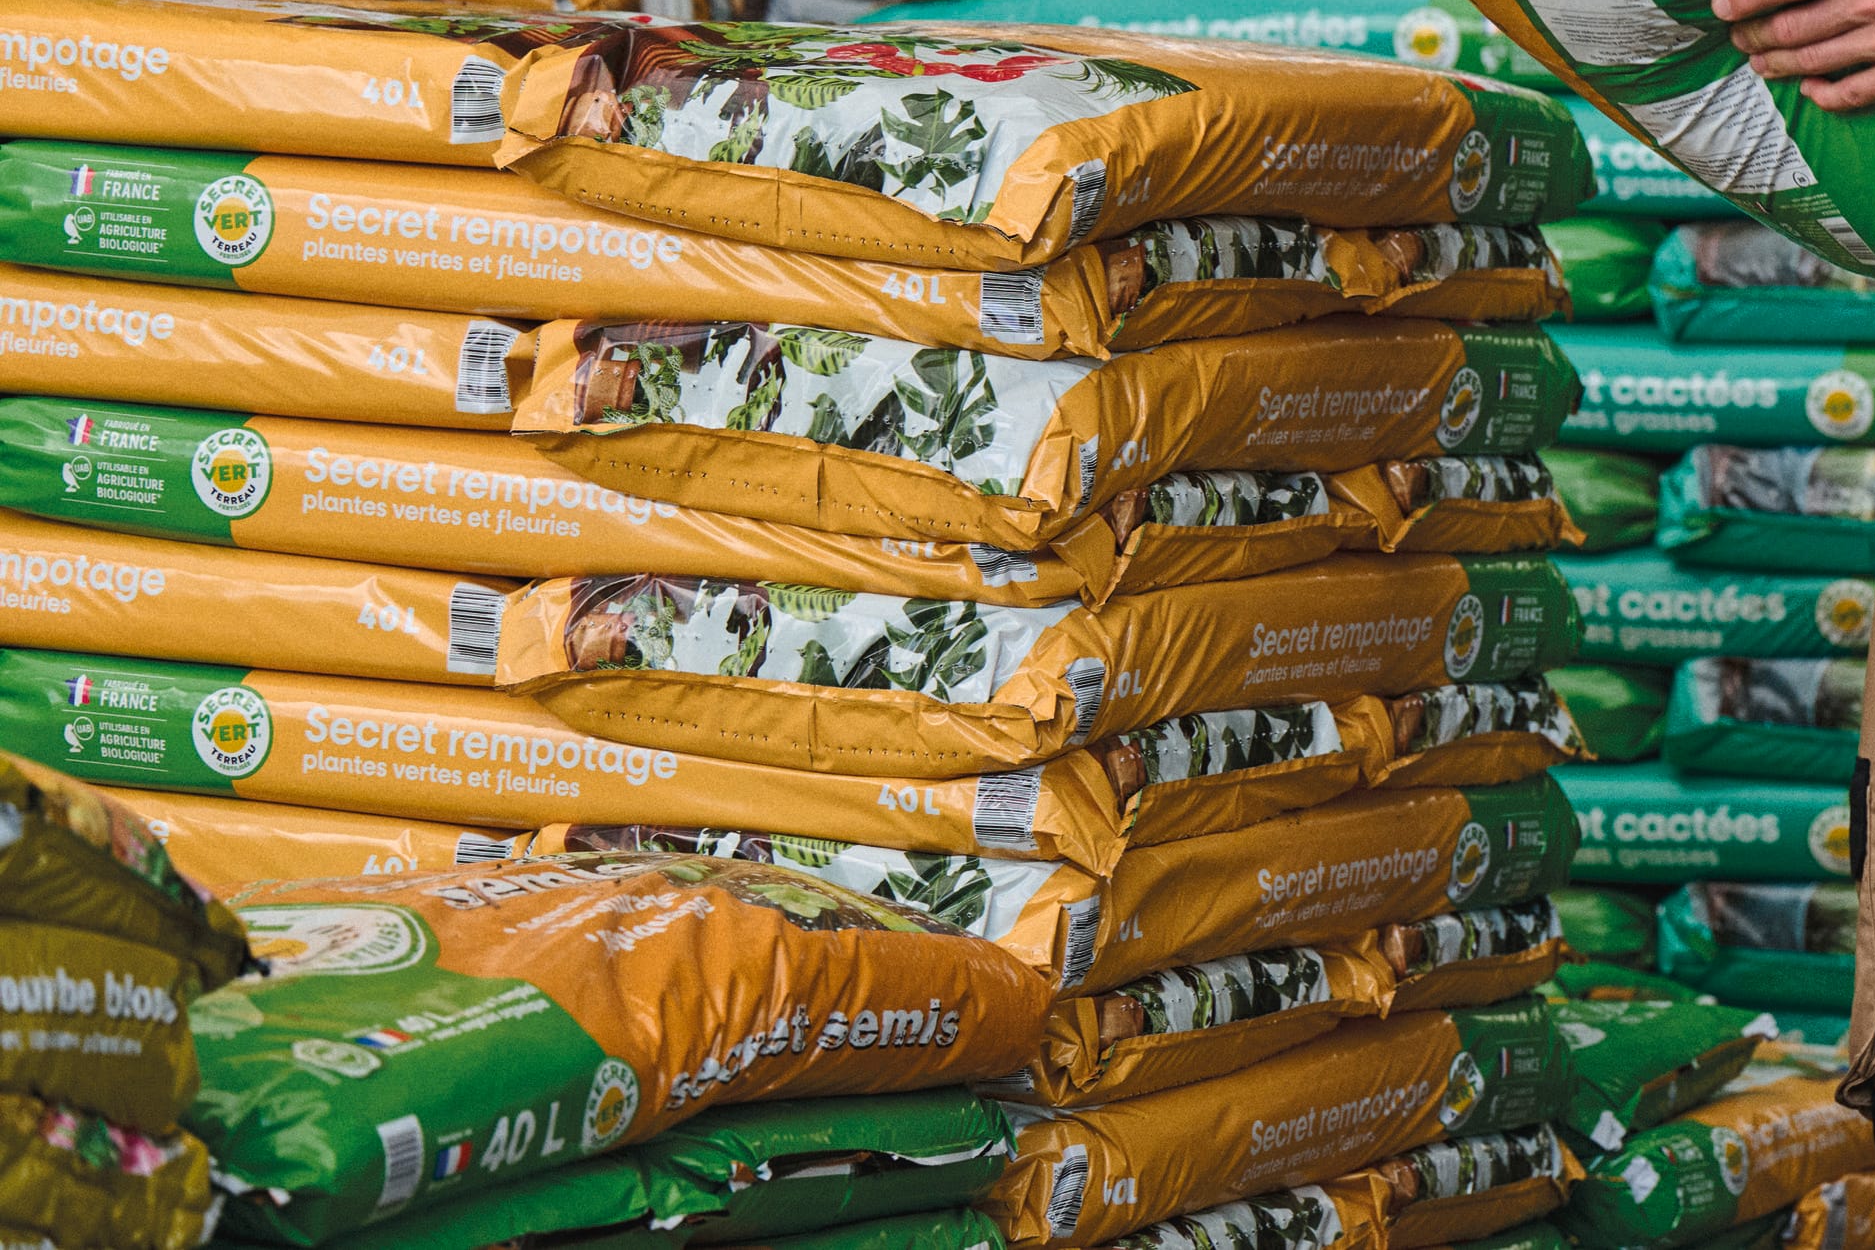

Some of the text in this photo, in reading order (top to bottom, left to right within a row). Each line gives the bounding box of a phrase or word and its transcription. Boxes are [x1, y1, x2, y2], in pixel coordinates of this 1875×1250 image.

[1261, 135, 1440, 181] Secret rempotage
[1521, 151, 1550, 168] FRANCE
[102, 180, 161, 201] FRANCE
[200, 179, 266, 213] SECRET
[77, 213, 92, 224] UAB
[101, 212, 152, 225] UTILISABLE EN
[203, 210, 263, 230] VERT
[99, 224, 167, 241] AGRICULTURE
[212, 232, 257, 254] TERREAU
[306, 193, 683, 270] Secret rempotage
[303, 237, 583, 283] plantes vertes et fleuries
[0, 330, 79, 358] fleuries
[1610, 370, 1779, 409] cactées
[1257, 386, 1321, 421] Secret
[104, 419, 151, 432] FABRIQUÉ EN
[101, 430, 160, 452] FRANCE
[198, 431, 265, 465] SECRET
[74, 463, 91, 474] UAB
[97, 461, 149, 475] UTILISABLE EN
[201, 463, 260, 483] VERT
[304, 446, 437, 496] Secret
[97, 472, 165, 492] AGRICULTURE
[210, 483, 256, 506] TERREAU
[302, 490, 581, 538] plantes vertes et fleuries
[1250, 612, 1433, 659] Secret rempotage
[1244, 665, 1290, 690] plantes
[1290, 660, 1325, 682] vertes
[1326, 658, 1338, 679] et
[101, 690, 159, 712] FRANCE
[198, 691, 264, 725] SECRET
[76, 723, 92, 734] UAB
[99, 721, 150, 735] UTILISABLE EN
[201, 722, 260, 743] VERT
[100, 733, 166, 752] AGRICULTURE
[304, 706, 679, 786] Secret rempotage
[211, 744, 256, 766] TERREAU
[302, 751, 581, 798] plantes vertes et fleuries
[1258, 846, 1440, 904] Secret rempotage
[817, 998, 960, 1050] semis
[541, 1101, 566, 1157] L
[1250, 1111, 1317, 1156] Secret
